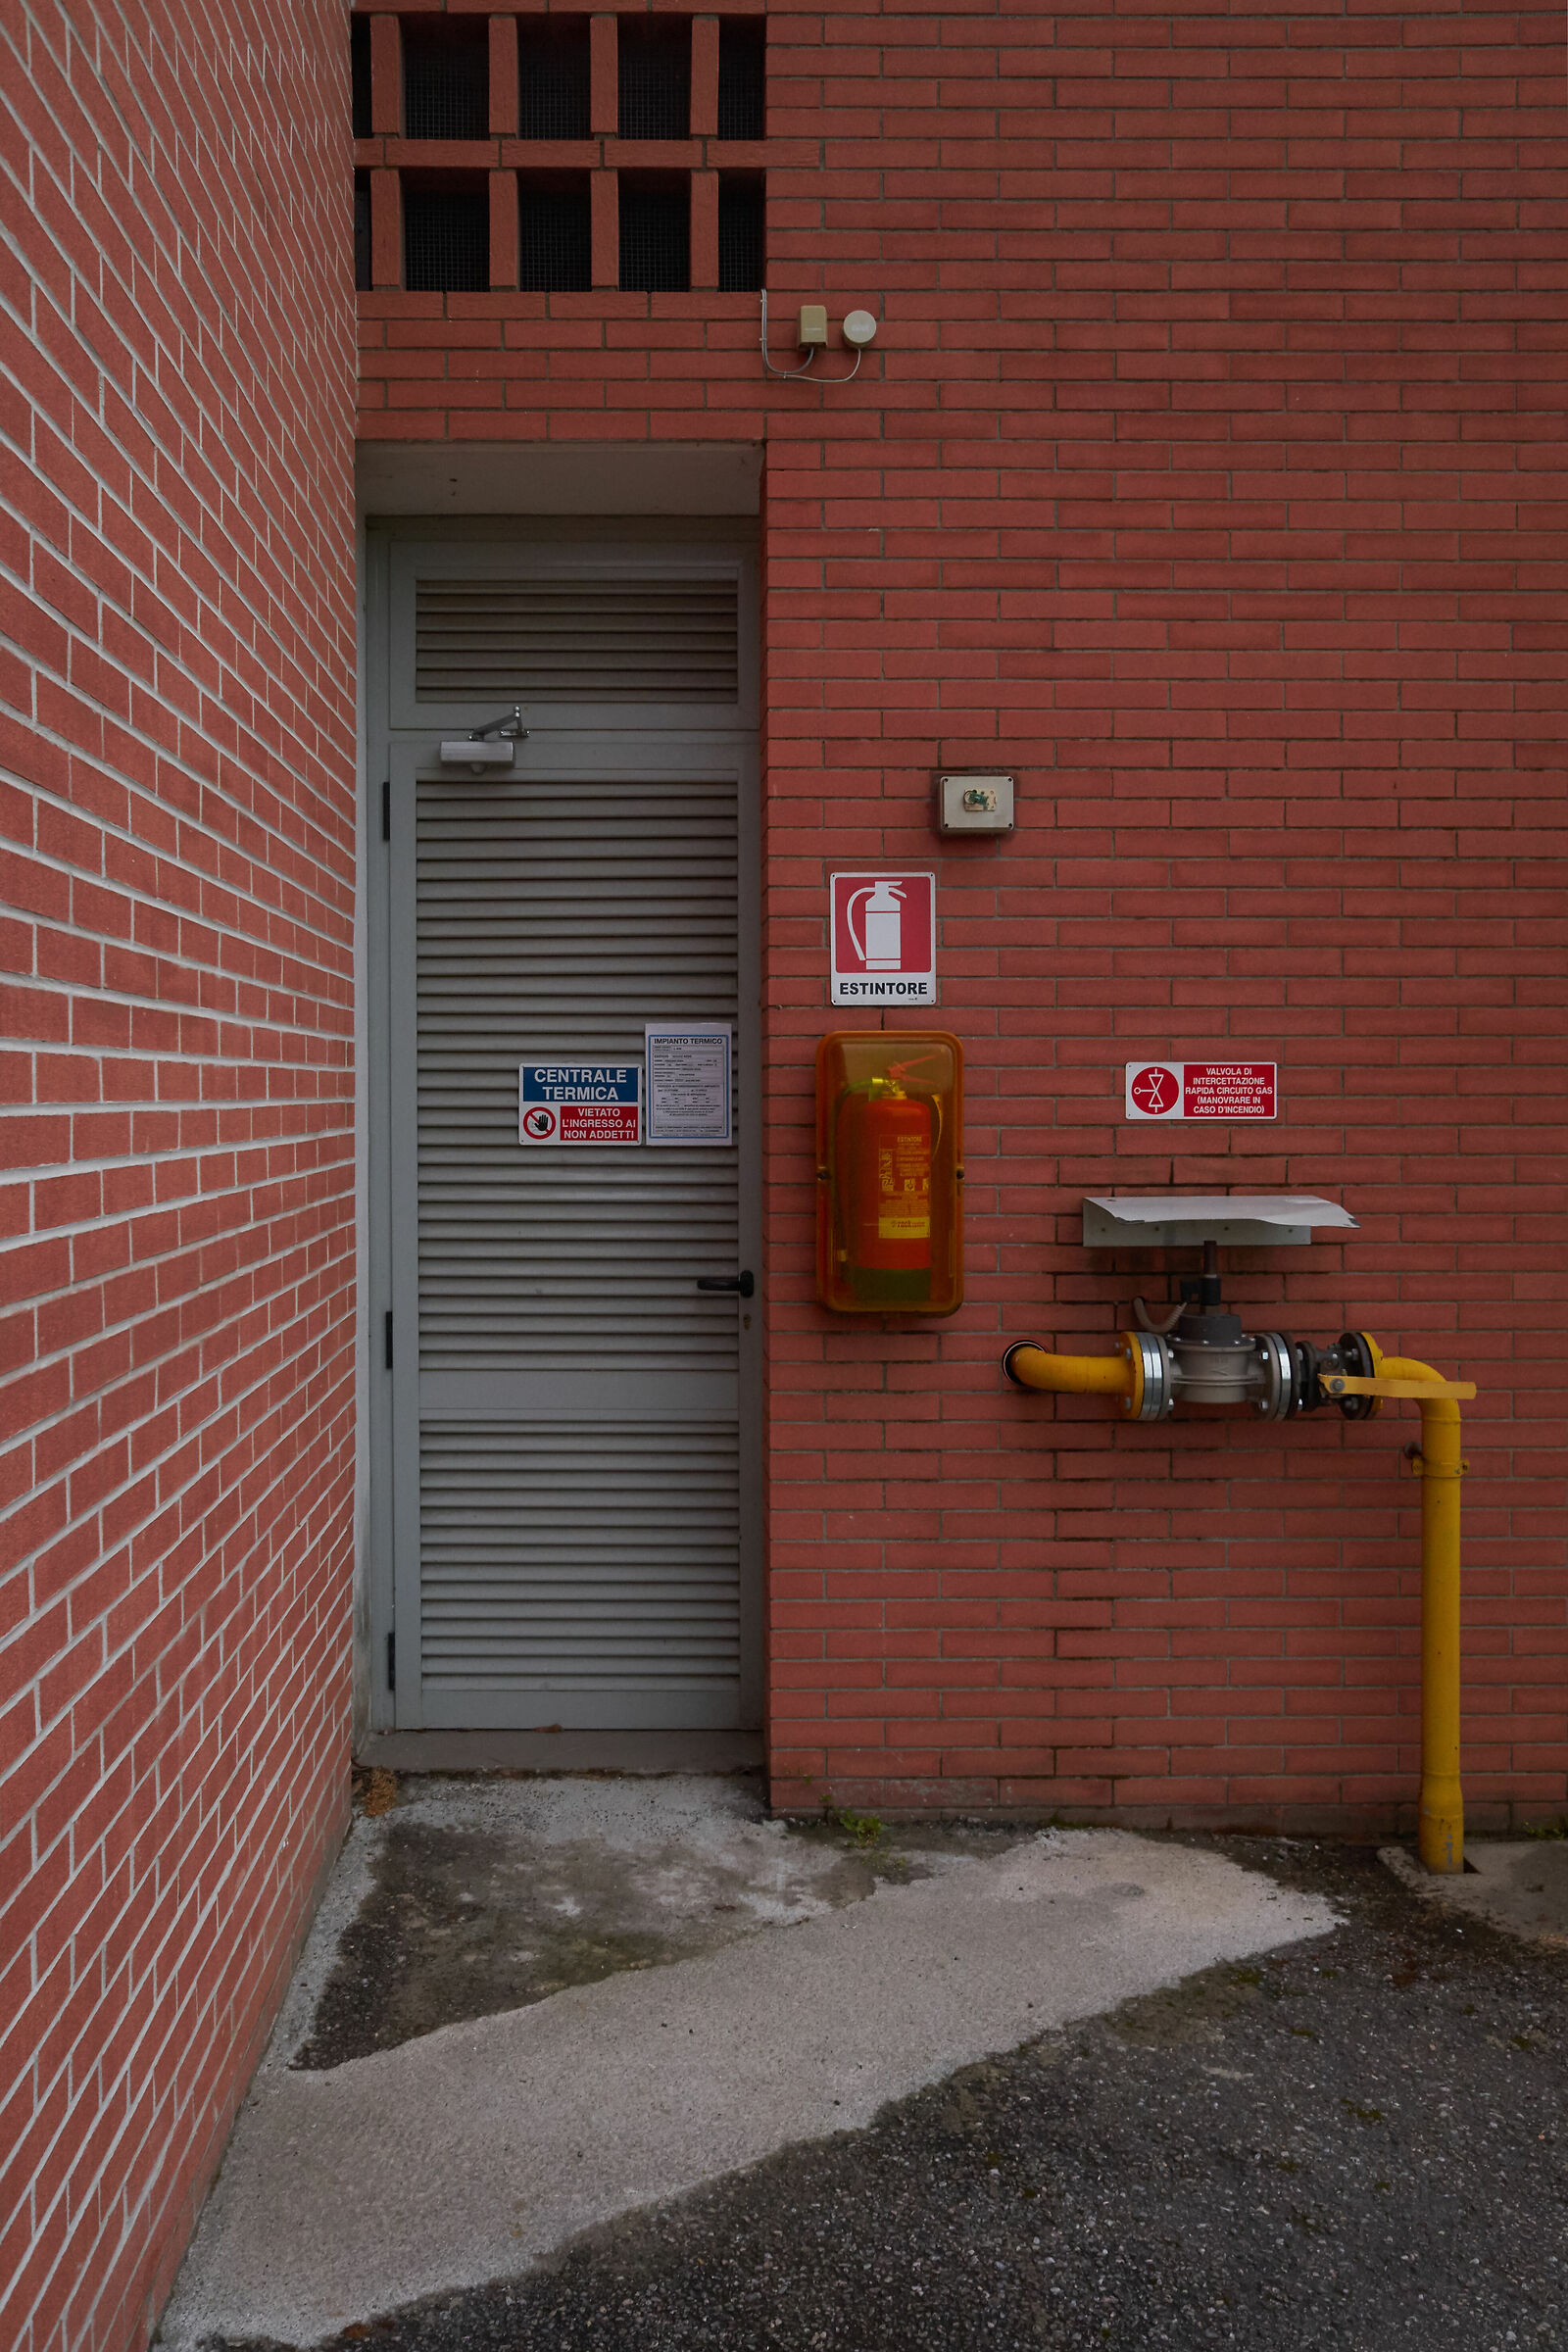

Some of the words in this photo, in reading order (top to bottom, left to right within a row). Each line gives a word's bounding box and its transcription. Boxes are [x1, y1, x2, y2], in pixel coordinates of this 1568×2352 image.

[839, 982, 928, 995] ESTINTORE
[534, 1068, 627, 1084] CENTRALE
[542, 1086, 619, 1101] TERMICA
[1197, 1096, 1250, 1104] (MANOVRARE
[1252, 1096, 1261, 1104] IN
[577, 1107, 620, 1117] VIETATO
[1217, 1105, 1265, 1114] D'INCENDIO)
[562, 1119, 623, 1128] L'INGRESSO
[625, 1119, 636, 1128] AI
[564, 1130, 588, 1139] NON
[589, 1130, 634, 1139] ADDETTI
